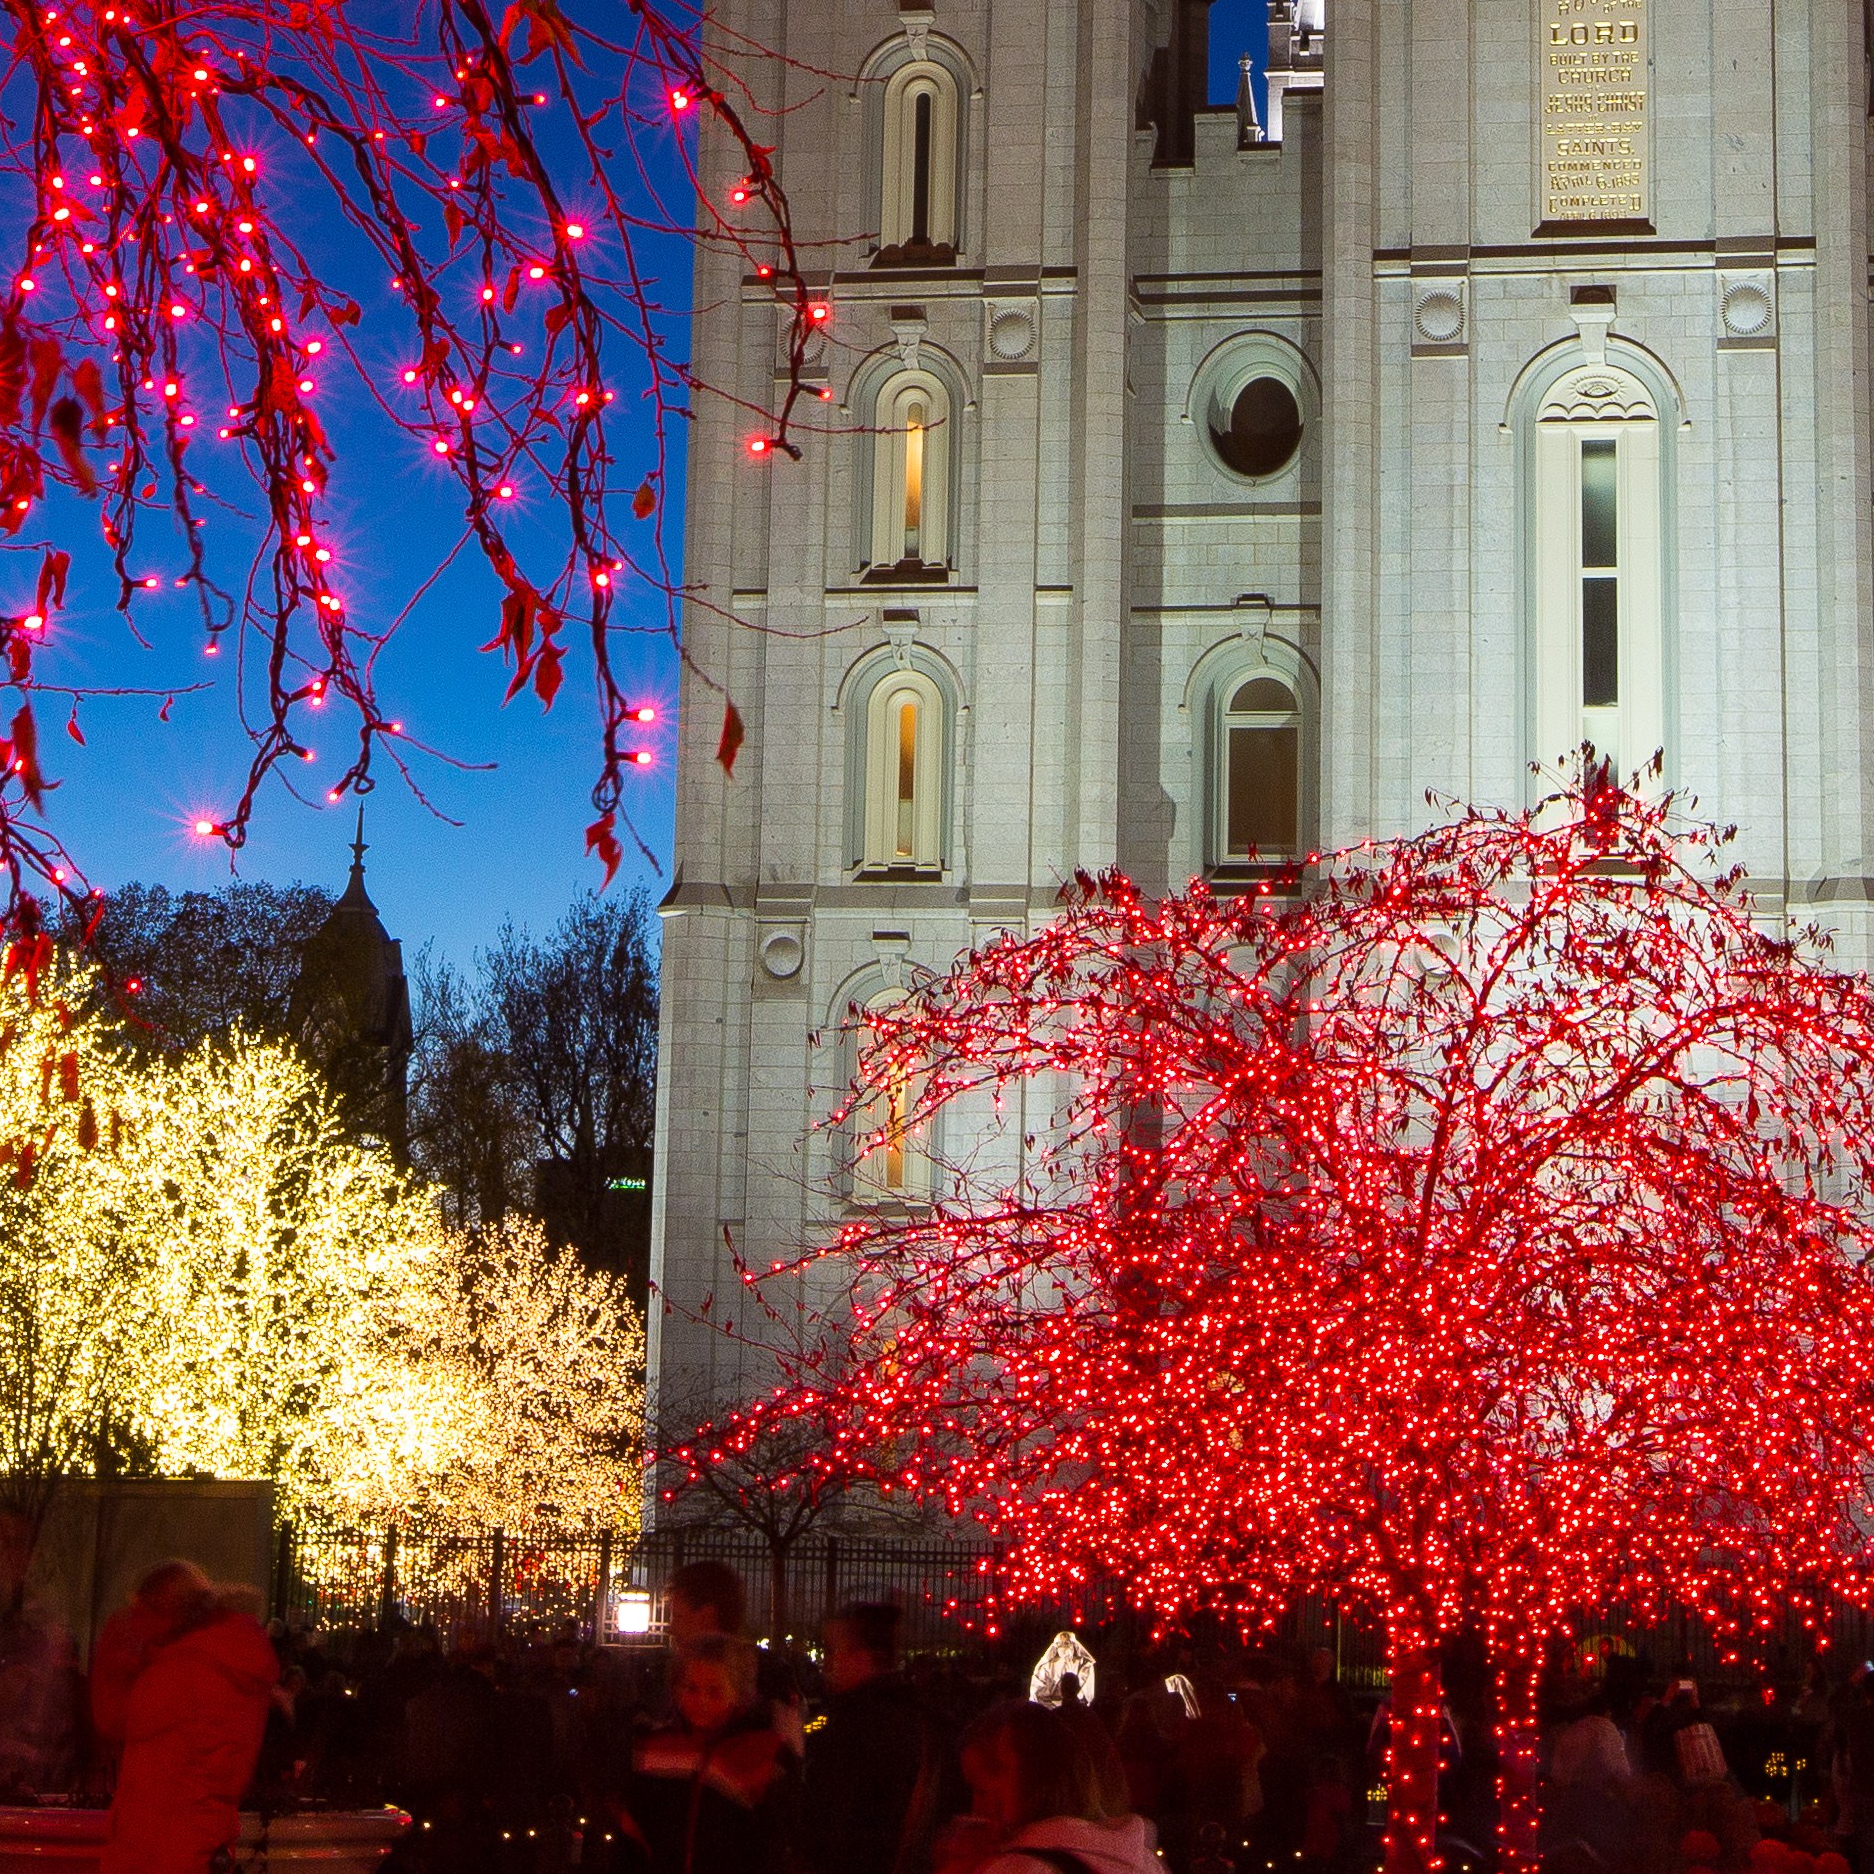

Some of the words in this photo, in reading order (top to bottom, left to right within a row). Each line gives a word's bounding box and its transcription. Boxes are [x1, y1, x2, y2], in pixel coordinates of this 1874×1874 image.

[1549, 20, 1638, 46] LORD
[1549, 52, 1588, 66] BUILT
[1592, 51, 1610, 64] BY
[1611, 50, 1639, 64] THE
[1558, 66, 1632, 84] CHURCH
[1544, 93, 1593, 114] JESUS
[1596, 91, 1646, 113] CHRIST
[1557, 137, 1635, 157] SAINTS.
[1548, 158, 1642, 172] COMMENCED
[1550, 172, 1593, 191] APRIL
[1549, 193, 1641, 213] COMPLETED
